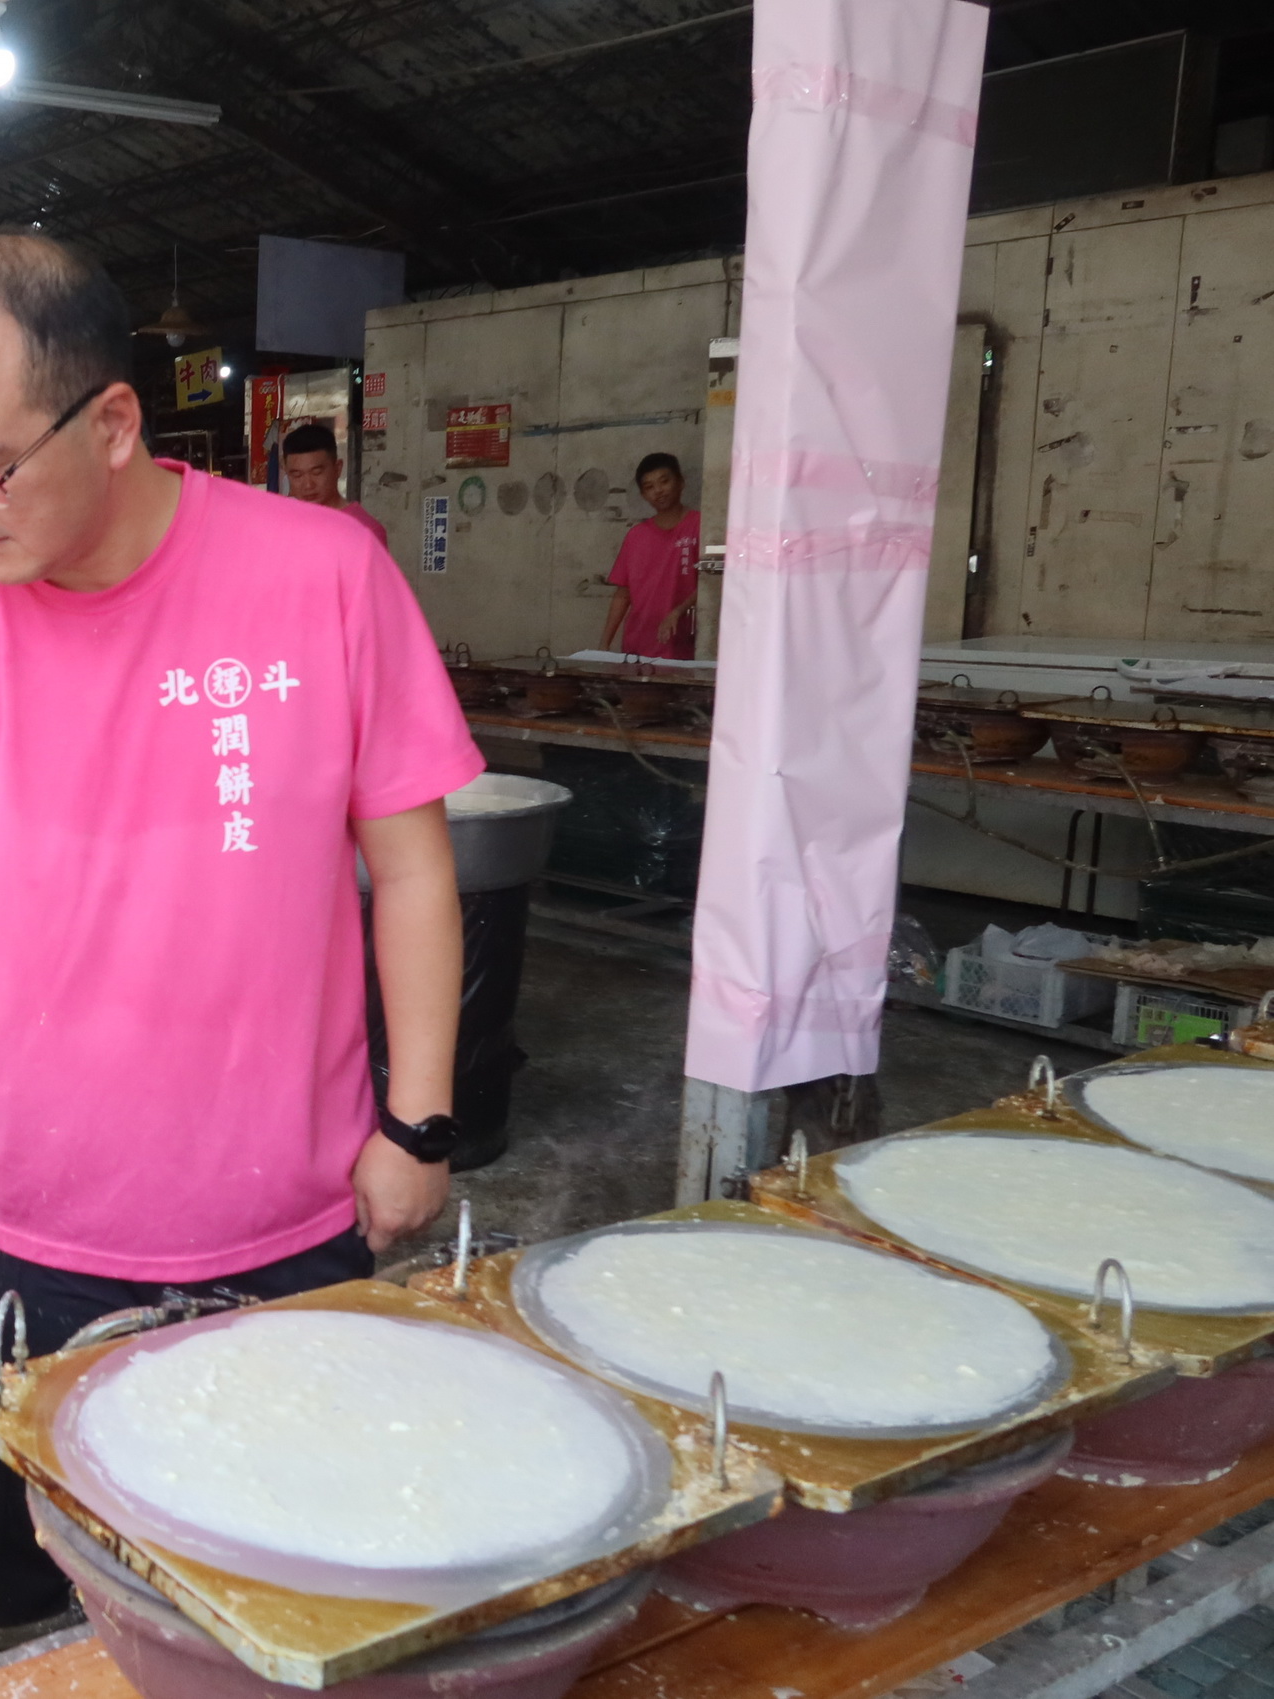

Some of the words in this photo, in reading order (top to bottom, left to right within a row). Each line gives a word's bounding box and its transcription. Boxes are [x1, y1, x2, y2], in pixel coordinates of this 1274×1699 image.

[179, 355, 217, 390] 牛肉
[211, 713, 259, 853] 潤餅皮
